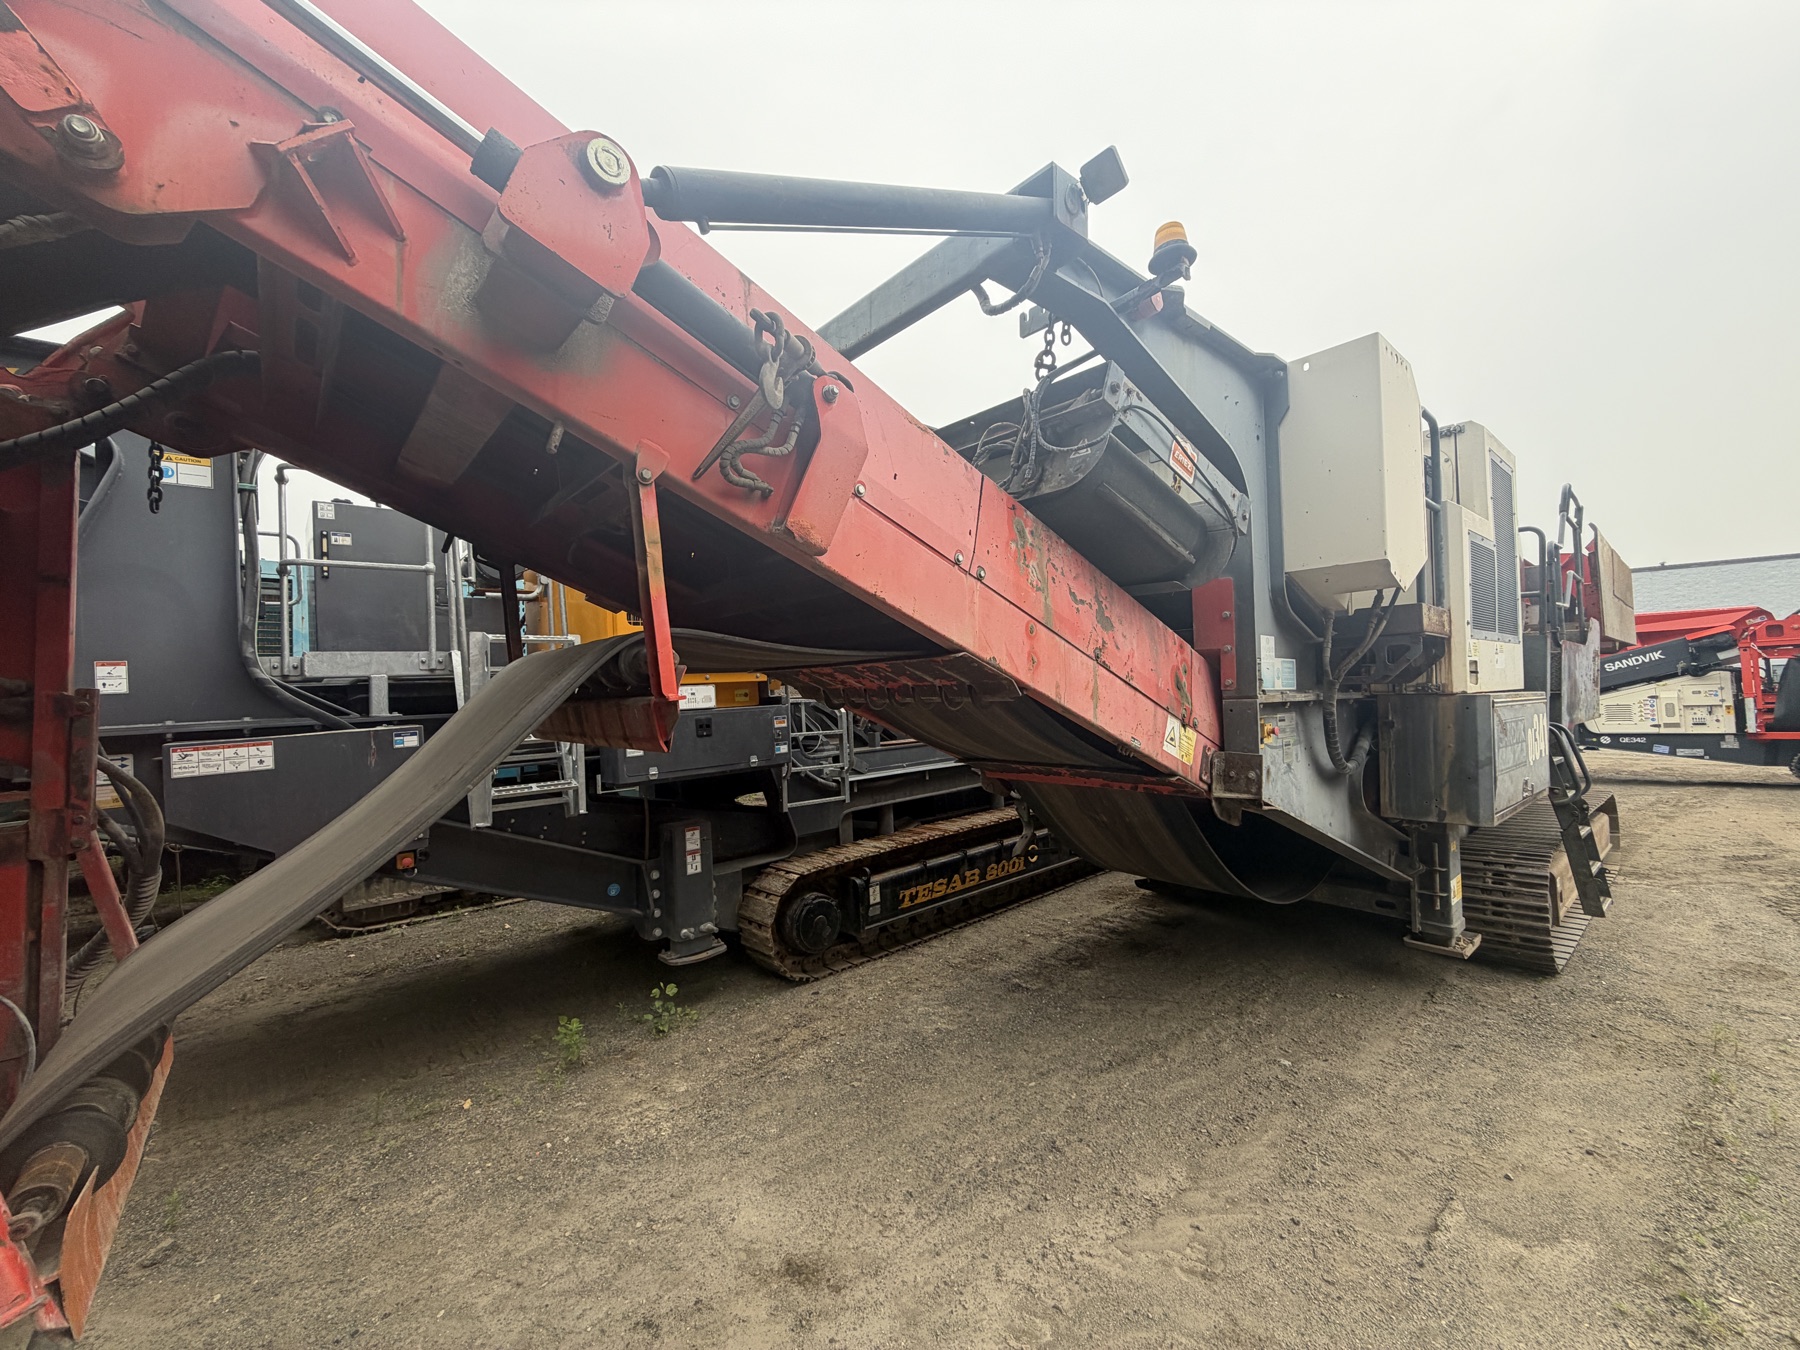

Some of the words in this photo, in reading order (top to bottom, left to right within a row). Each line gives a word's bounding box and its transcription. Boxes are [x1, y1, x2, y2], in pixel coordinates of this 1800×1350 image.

[174, 456, 202, 464] CAUTION
[1604, 650, 1666, 672] SANDVIK
[899, 868, 981, 909] TESAB
